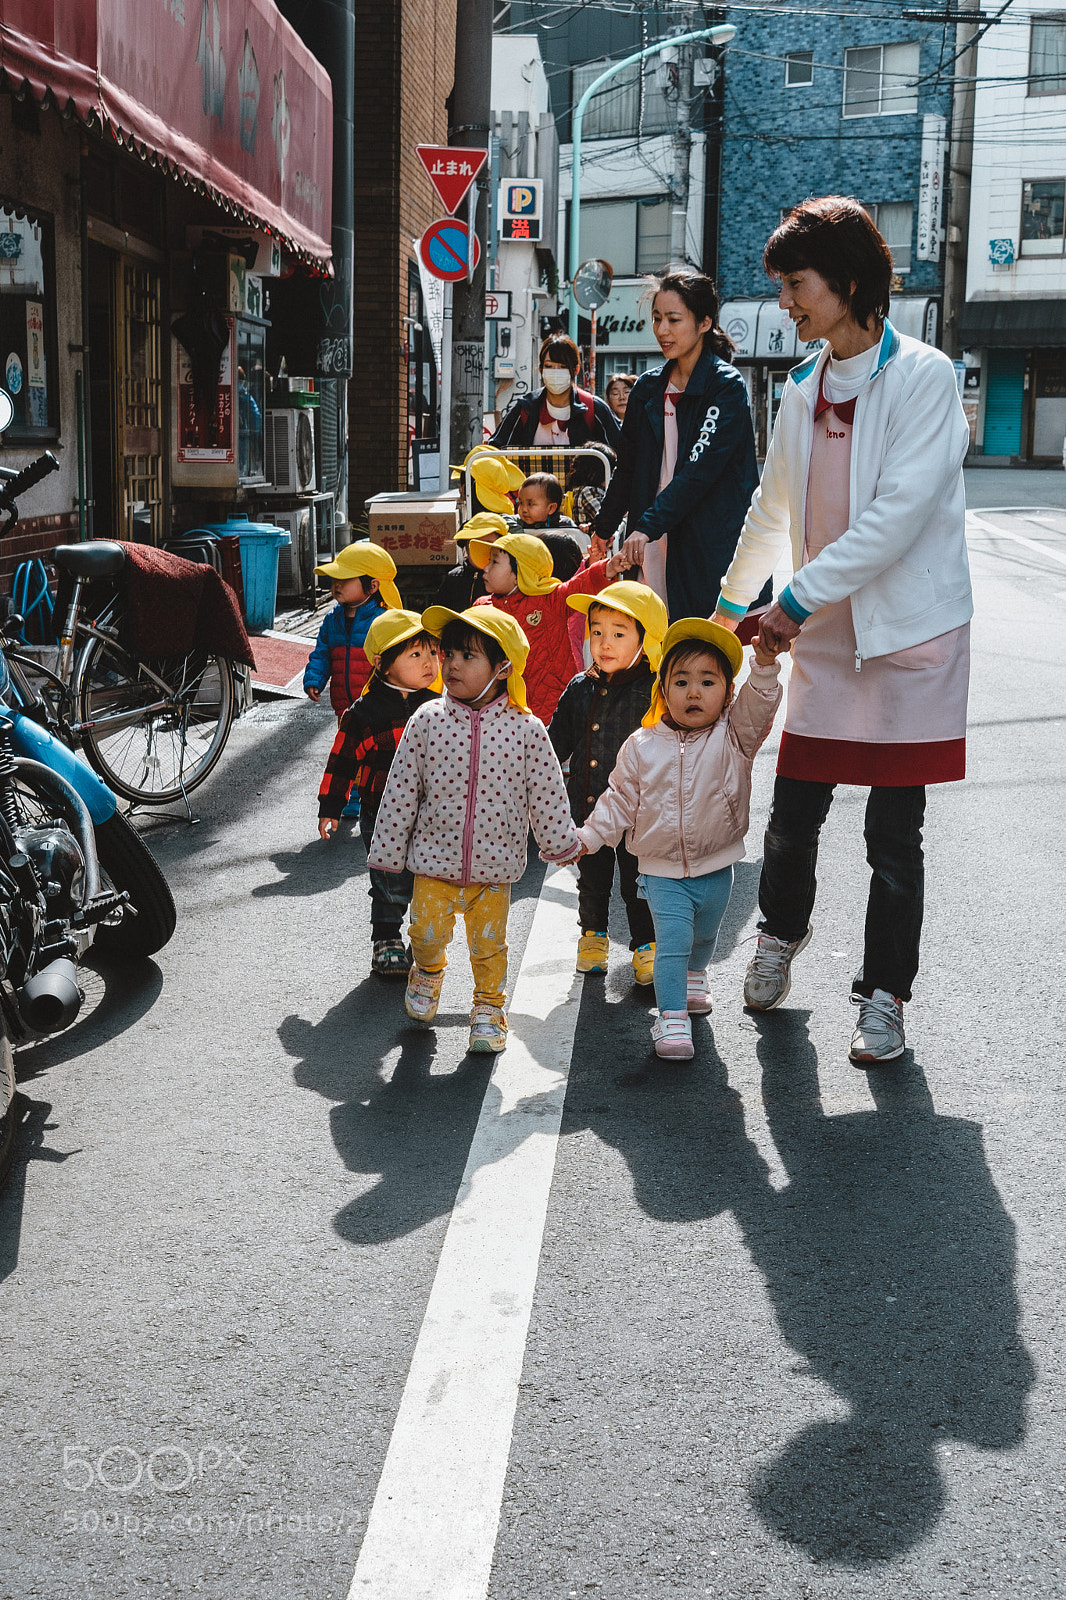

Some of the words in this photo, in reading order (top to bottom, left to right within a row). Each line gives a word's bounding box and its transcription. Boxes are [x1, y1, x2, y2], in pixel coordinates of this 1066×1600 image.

[430, 159, 474, 176] 止まれ
[511, 187, 533, 212] P
[511, 219, 530, 238] 満
[689, 405, 721, 462] adidas
[380, 533, 447, 552] たまねぎ
